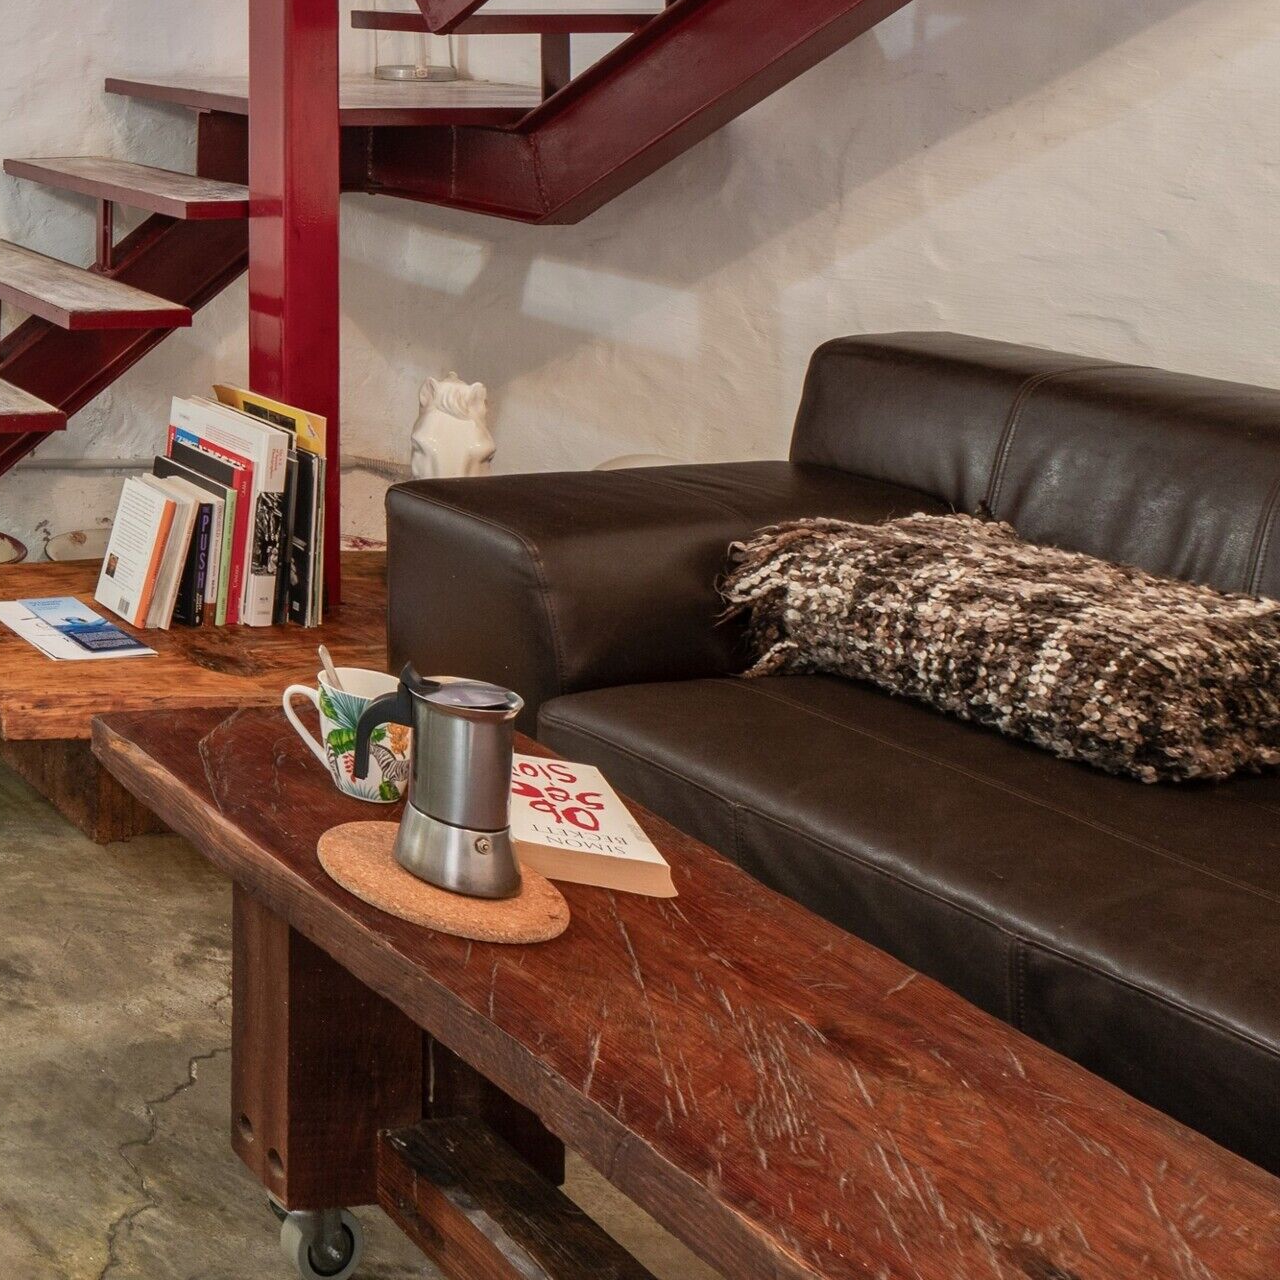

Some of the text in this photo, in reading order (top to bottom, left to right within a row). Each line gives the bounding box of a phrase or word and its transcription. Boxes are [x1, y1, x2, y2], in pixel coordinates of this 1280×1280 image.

[197, 515, 209, 589] PUSH
[530, 824, 628, 846] BECKETT
[544, 835, 626, 855] SIMON
